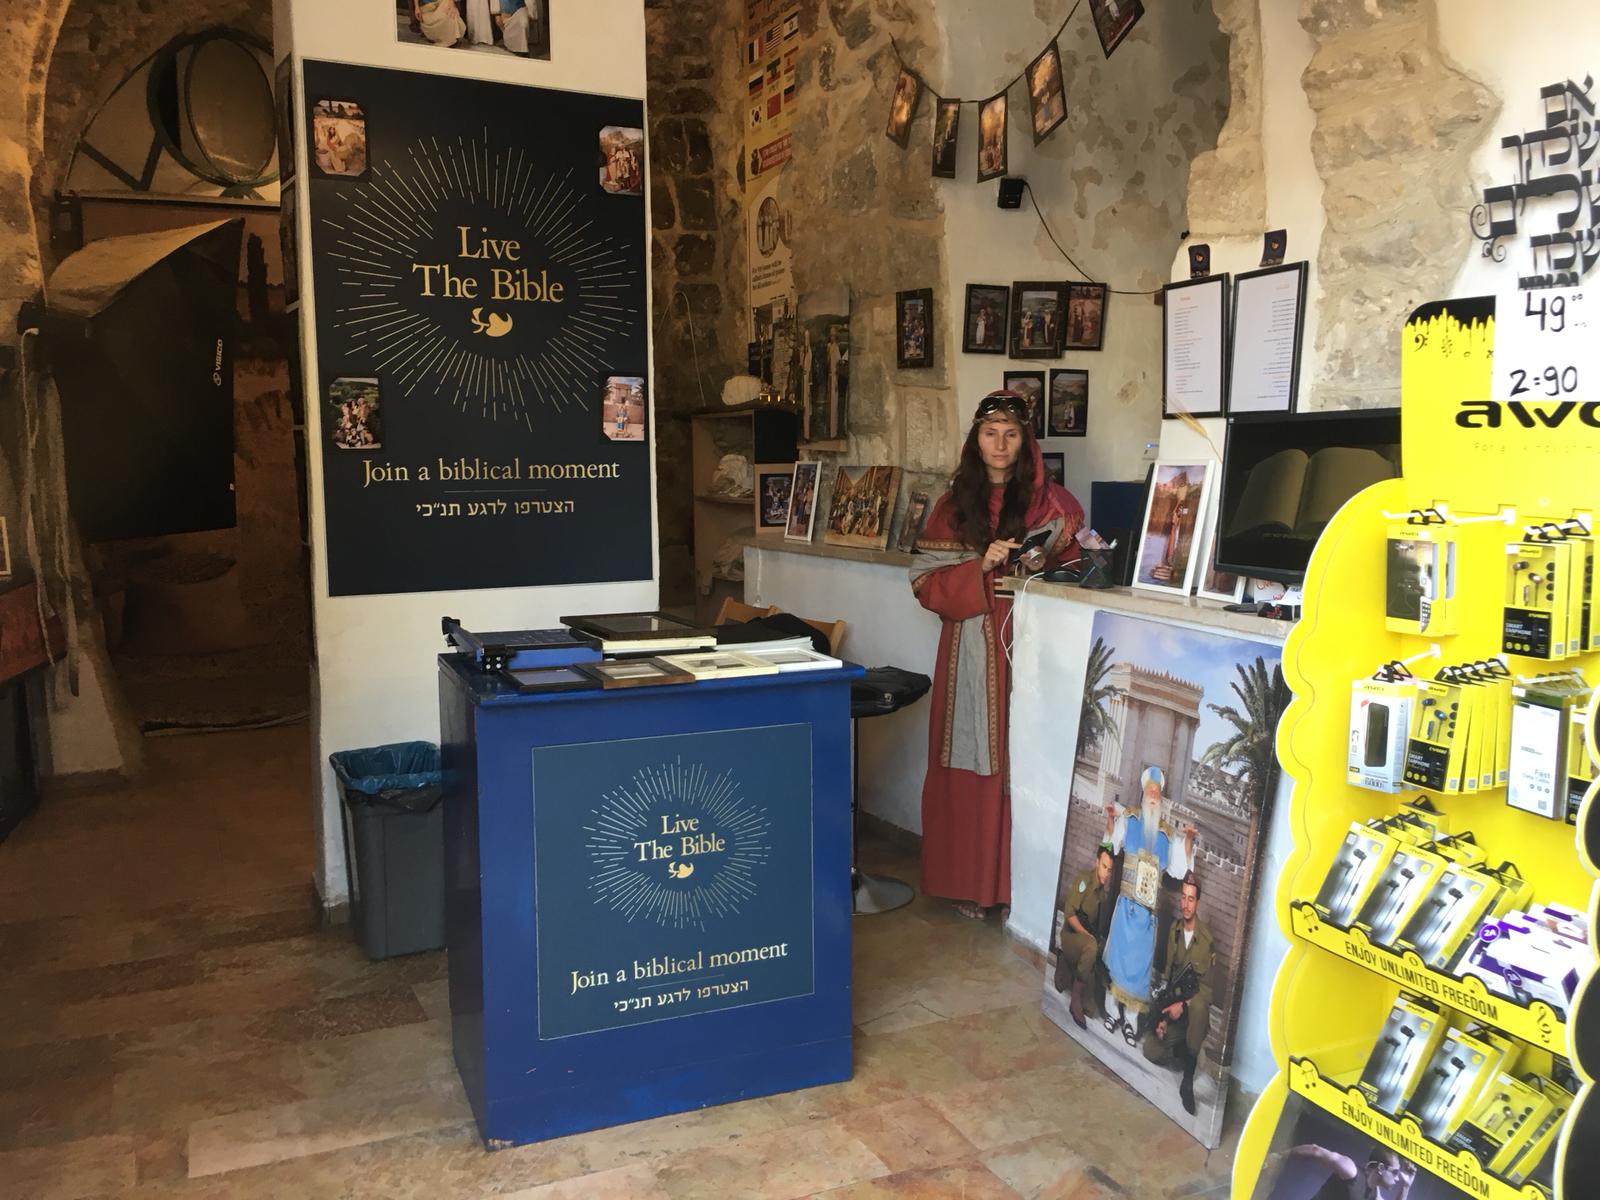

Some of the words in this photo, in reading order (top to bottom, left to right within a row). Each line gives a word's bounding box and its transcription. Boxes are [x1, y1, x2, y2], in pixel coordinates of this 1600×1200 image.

[457, 225, 520, 261] Live
[412, 263, 478, 299] The
[490, 267, 564, 303] Bible
[362, 460, 410, 488] Join
[418, 469, 430, 481] a
[438, 457, 521, 481] biblical
[528, 461, 620, 480] moment
[468, 498, 507, 516] לרגע
[515, 499, 575, 515] הצטרפו
[661, 814, 699, 835] Live
[633, 839, 673, 862] The
[680, 832, 726, 856] Bible
[570, 969, 609, 996] Join
[616, 969, 627, 983] a
[633, 951, 704, 980] biblical
[709, 942, 788, 968] moment
[1345, 941, 1378, 967] ENJOY
[1379, 957, 1440, 995] UNLIMITED
[1442, 984, 1499, 1021] FREEDOM
[657, 988, 691, 1006] לרגע
[697, 980, 749, 999] הצטרפו
[1341, 1101, 1374, 1132] ENJOY
[1375, 1122, 1434, 1165] UNLIMITED
[1436, 1155, 1490, 1198] FREEDOM
